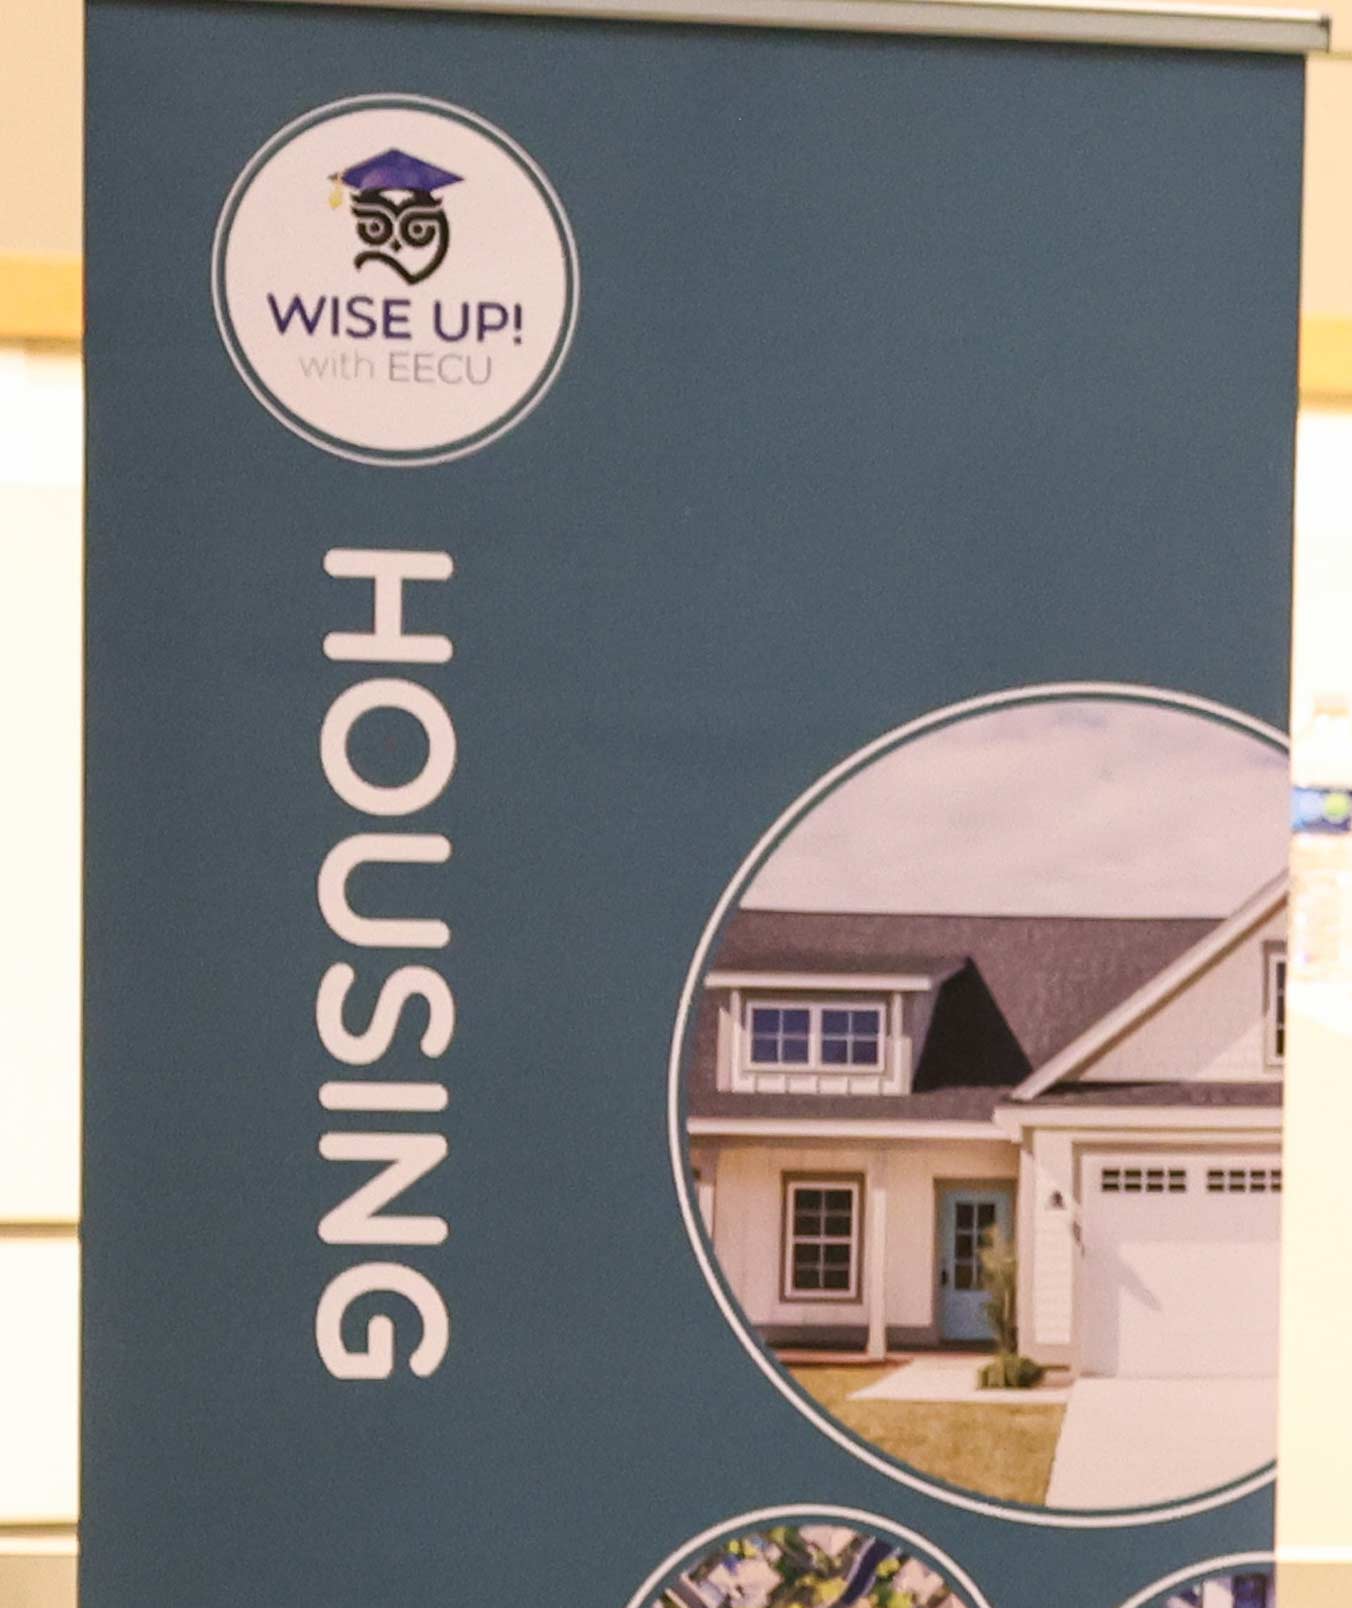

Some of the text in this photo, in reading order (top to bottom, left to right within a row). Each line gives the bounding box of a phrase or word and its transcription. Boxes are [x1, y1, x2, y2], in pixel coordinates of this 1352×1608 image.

[267, 293, 523, 345] WISE UP!
[299, 350, 493, 386] with EECU
[314, 547, 458, 1380] HOUSING
